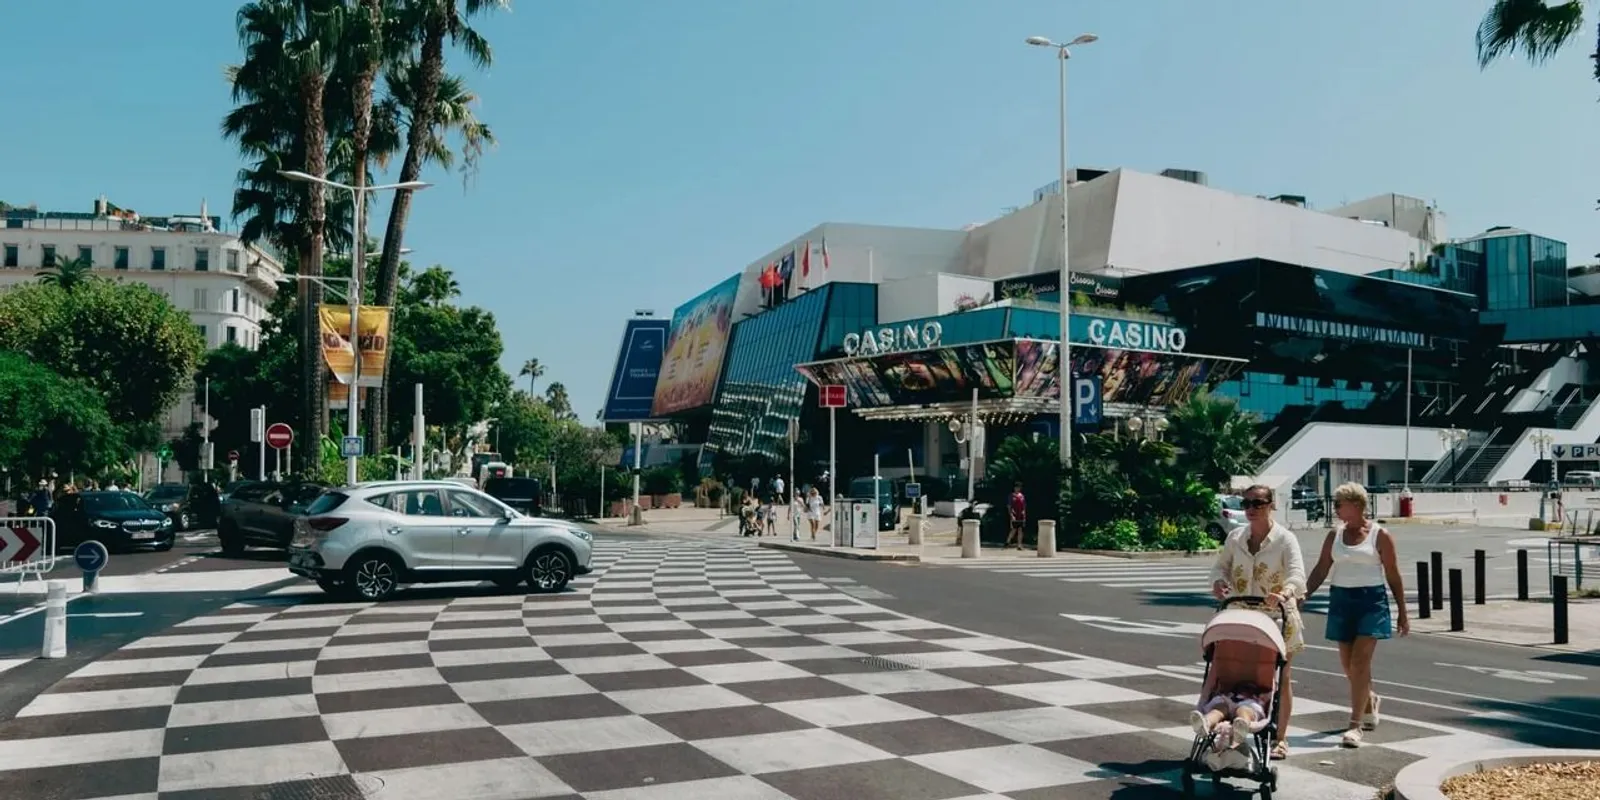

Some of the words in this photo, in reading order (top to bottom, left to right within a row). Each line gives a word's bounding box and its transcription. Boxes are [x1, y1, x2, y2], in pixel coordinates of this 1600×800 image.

[843, 321, 942, 355] CASINO
[1088, 319, 1186, 351] CASINO
[1076, 379, 1095, 417] P
